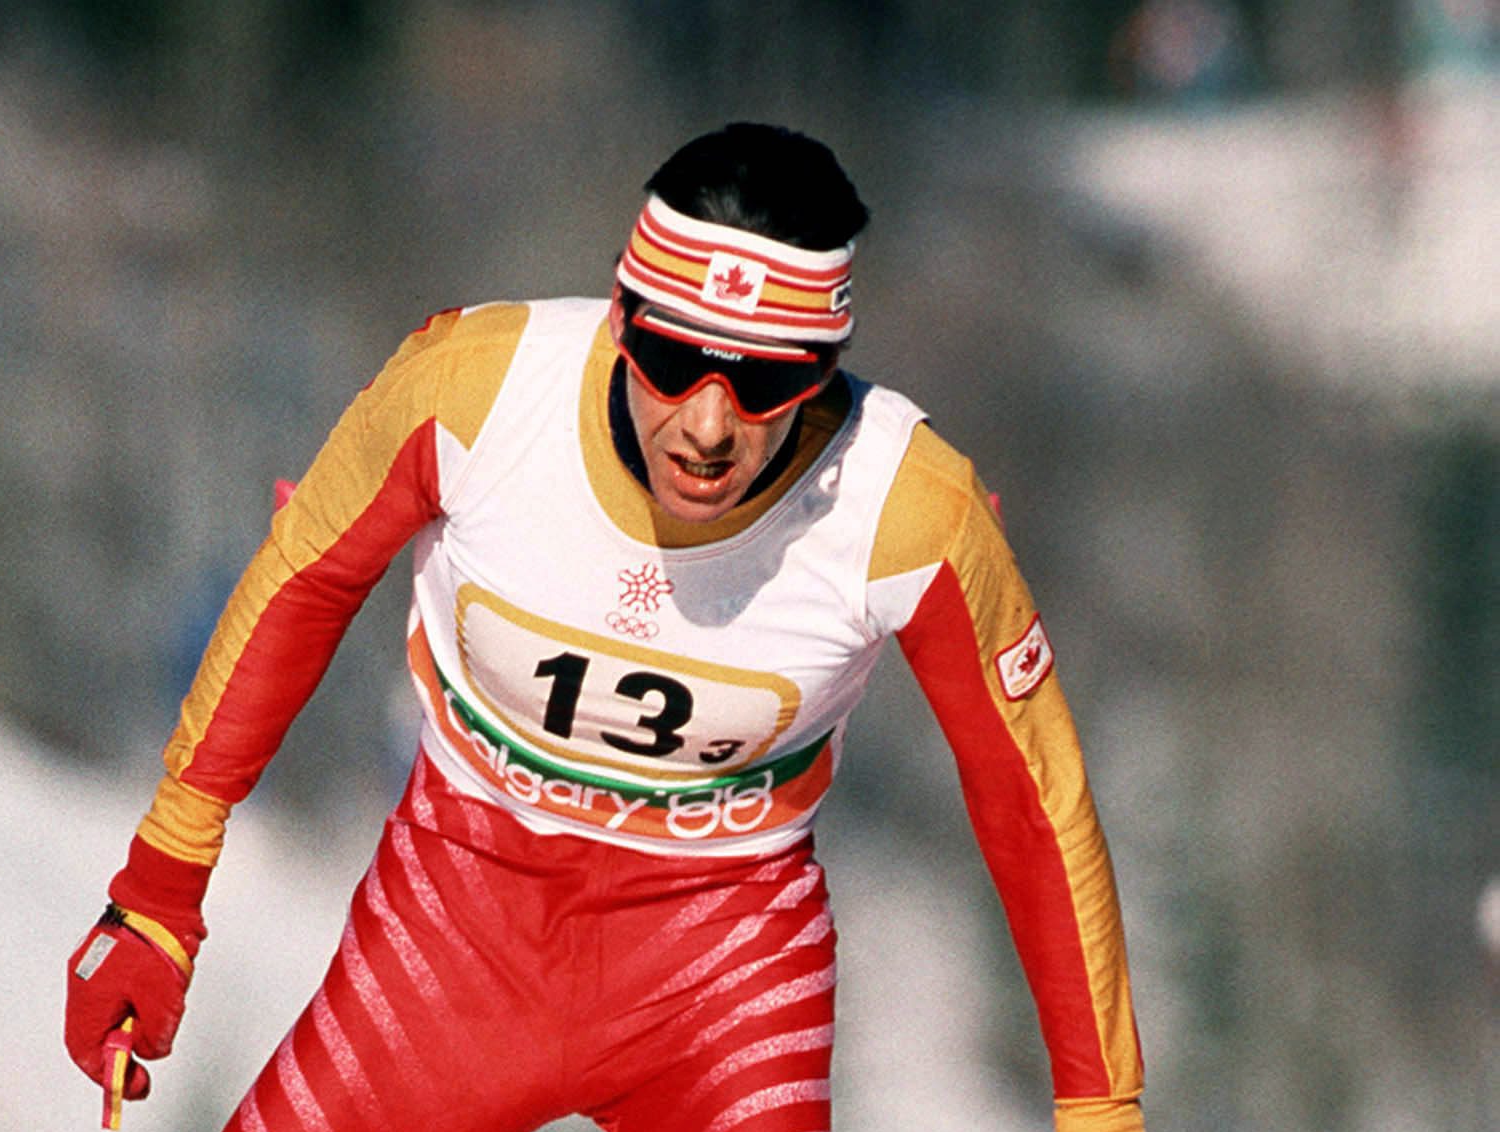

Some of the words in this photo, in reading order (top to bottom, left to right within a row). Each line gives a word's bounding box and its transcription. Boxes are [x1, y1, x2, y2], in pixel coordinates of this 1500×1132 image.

[446, 687, 648, 831] Calgary
[534, 652, 694, 758] 13
[699, 739, 746, 764] 3
